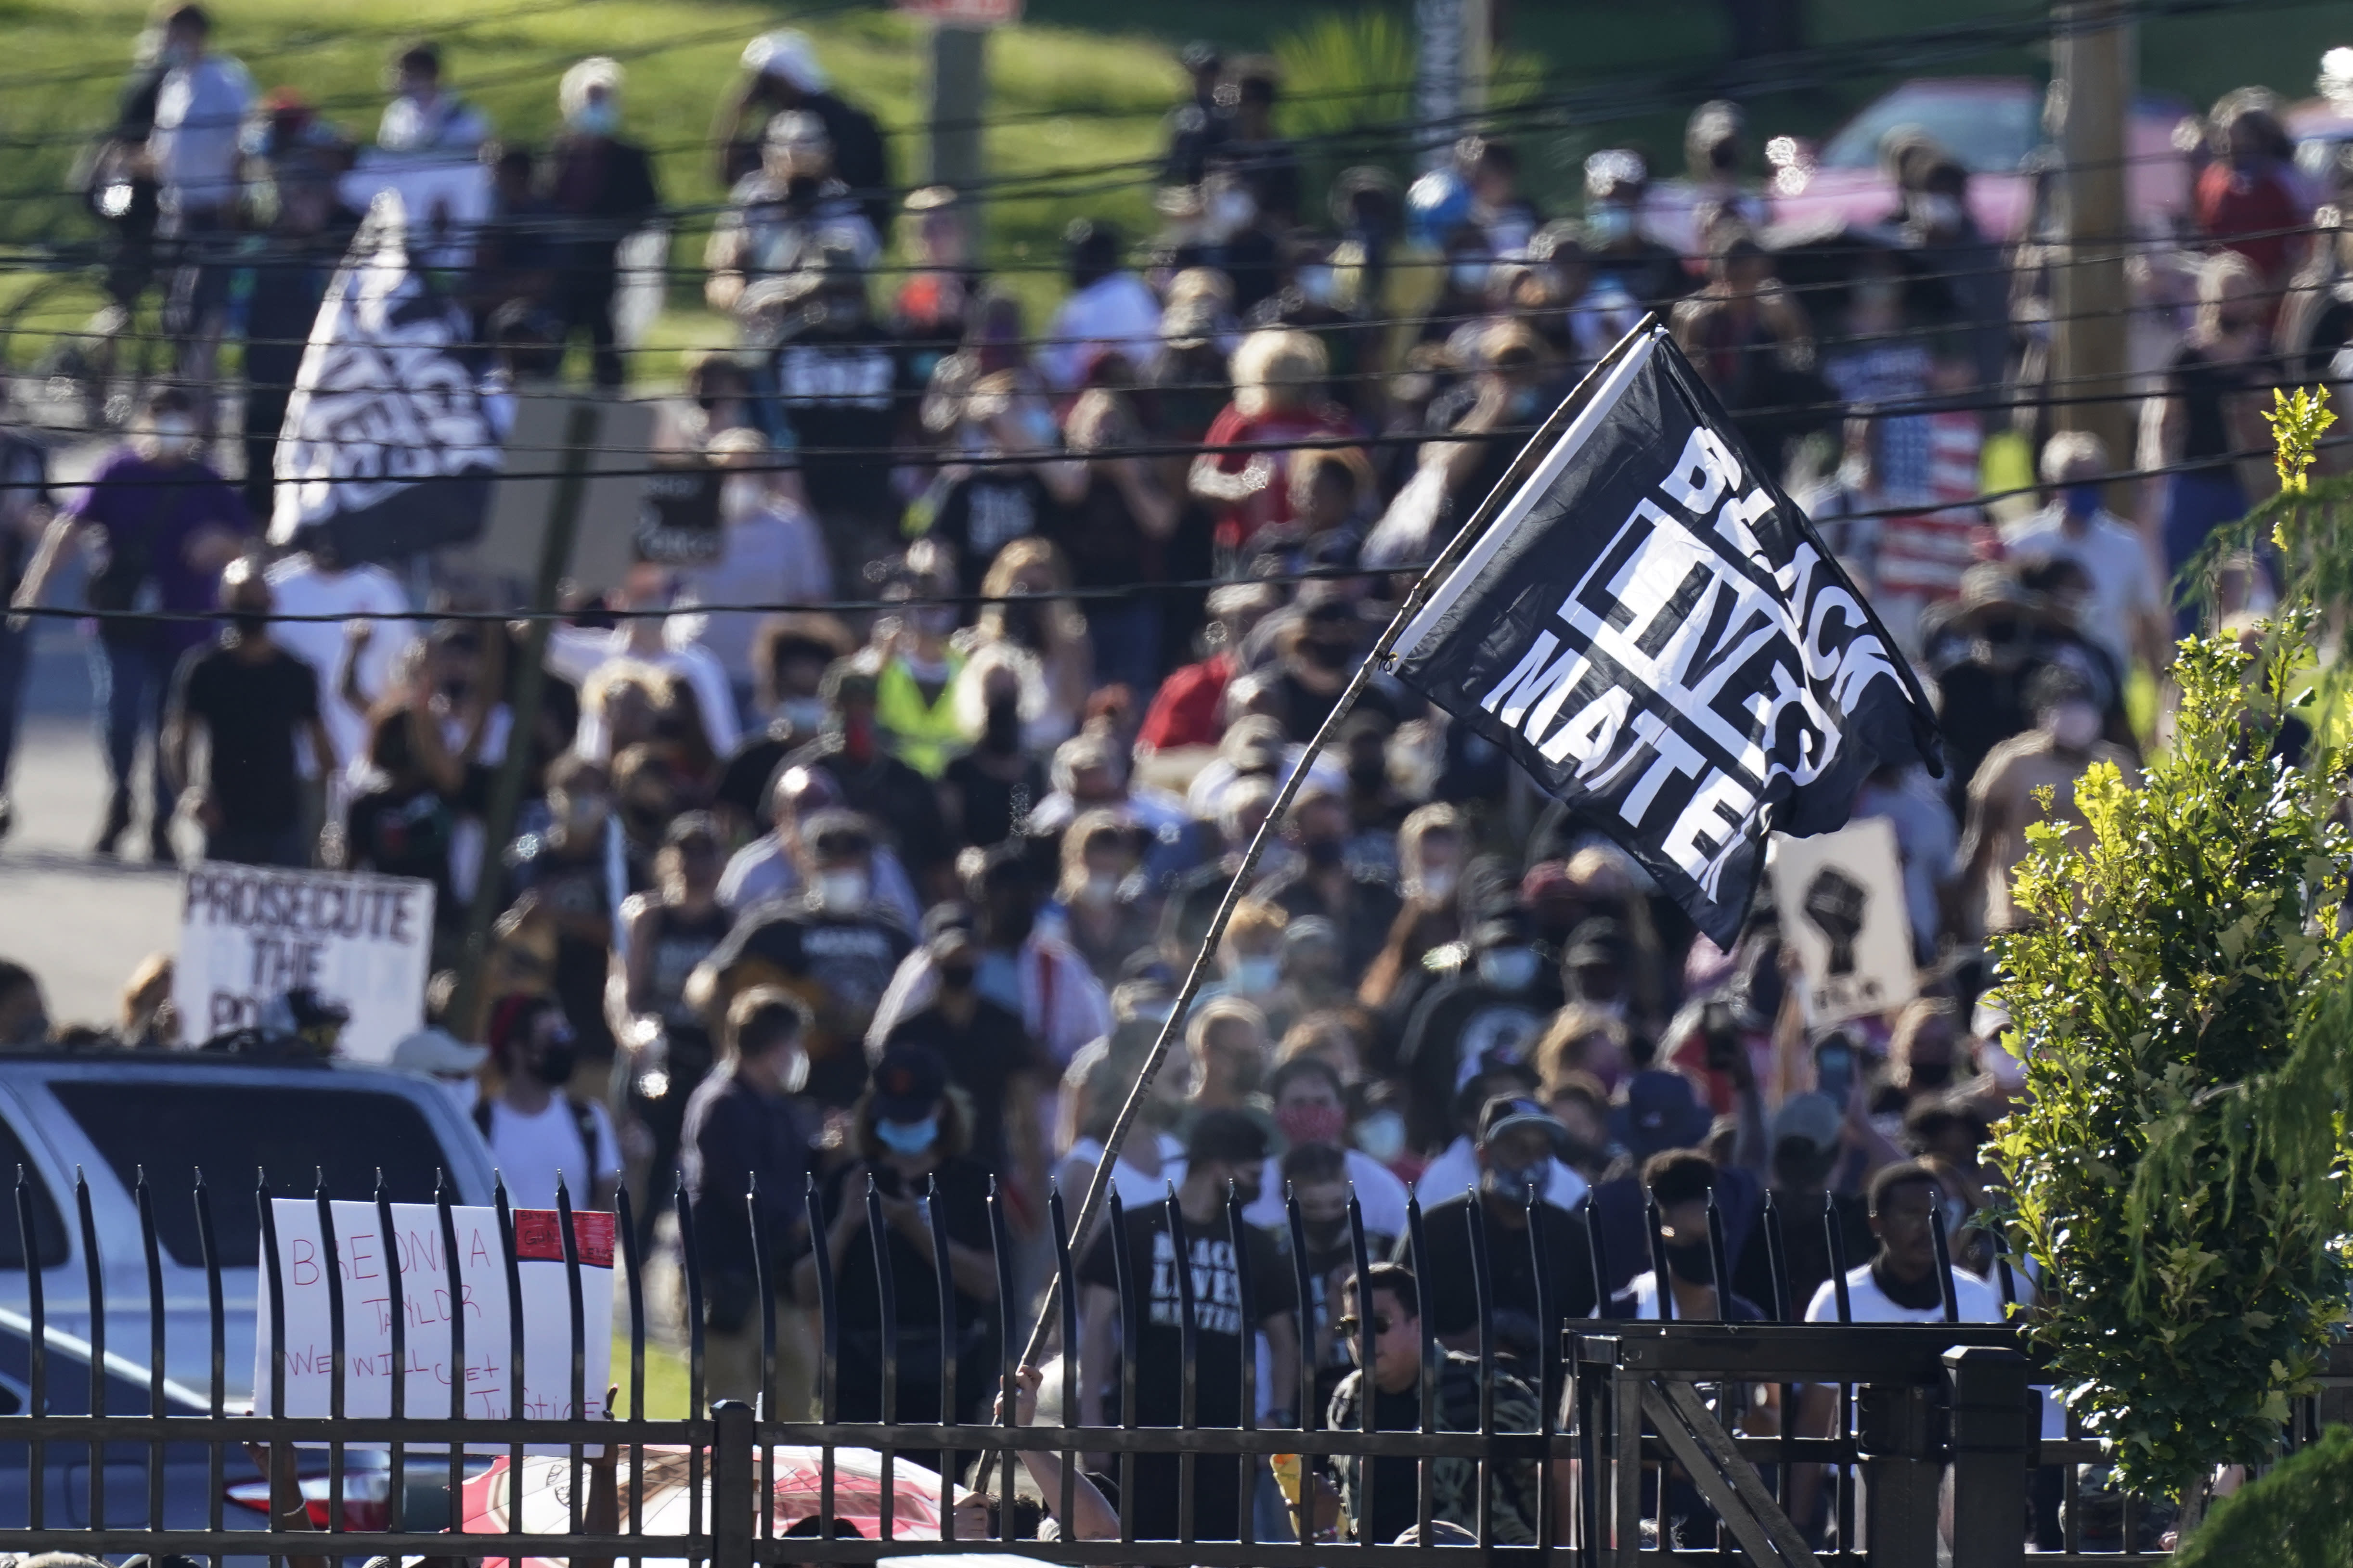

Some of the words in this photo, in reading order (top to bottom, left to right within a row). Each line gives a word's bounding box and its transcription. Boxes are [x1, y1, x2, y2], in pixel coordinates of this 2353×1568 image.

[1658, 426, 1914, 718] BLACK
[1557, 496, 1842, 788] LIVES
[1481, 629, 1757, 904] MATTE
[184, 872, 415, 946] PROSECUTE
[253, 937, 323, 990] THE
[524, 1230, 555, 1245] GUN
[362, 1285, 481, 1336] TAYLOR
[283, 1344, 332, 1376] WE
